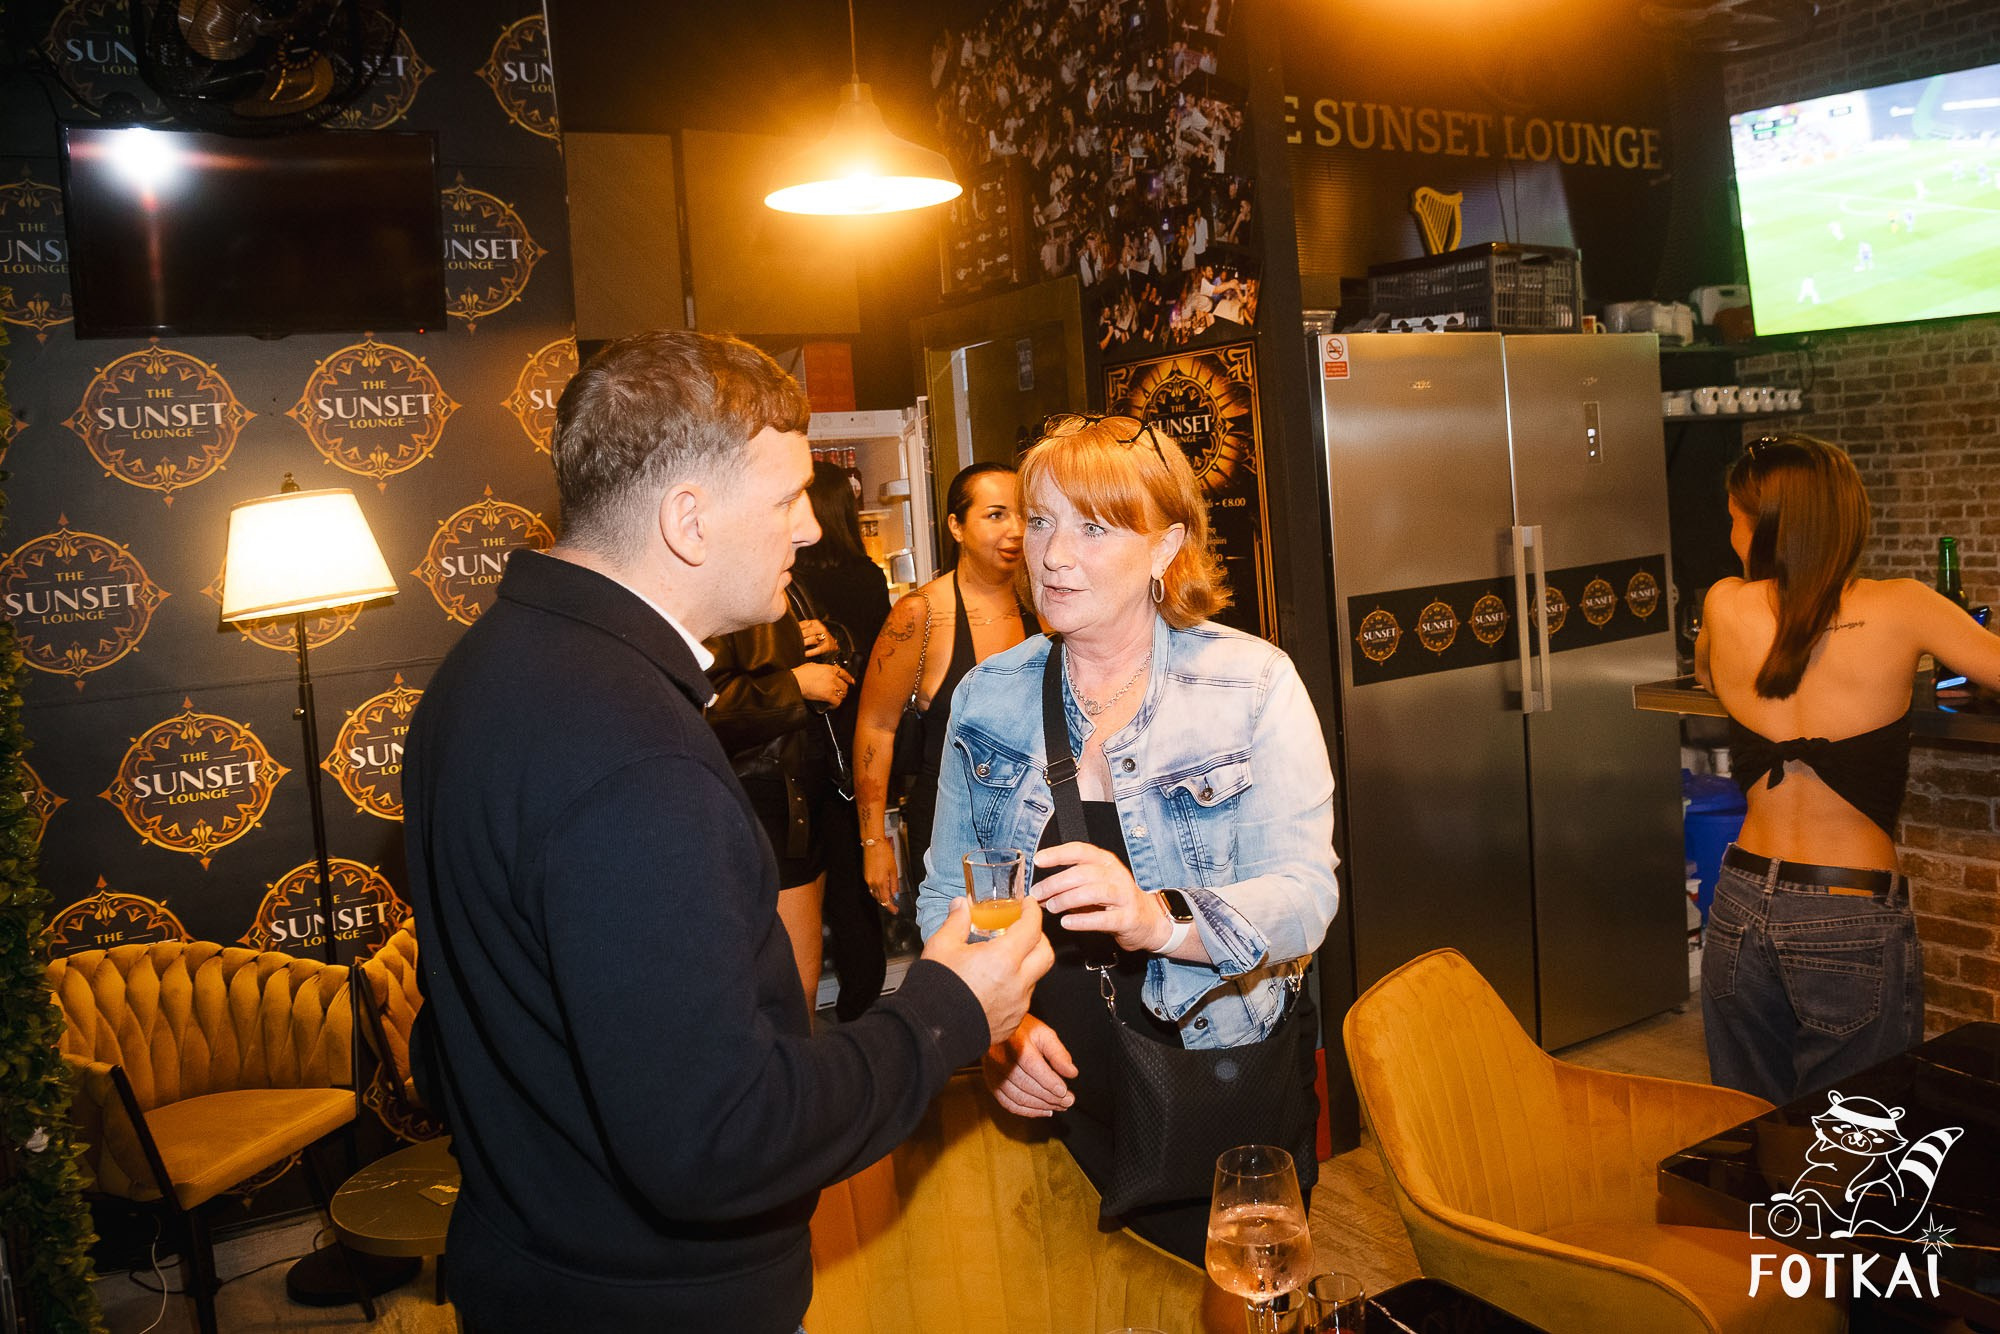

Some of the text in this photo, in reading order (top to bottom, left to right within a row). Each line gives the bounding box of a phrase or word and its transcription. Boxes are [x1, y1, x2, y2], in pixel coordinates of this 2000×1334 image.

[66, 39, 137, 63] SUN
[504, 61, 552, 83] SUN
[1313, 99, 1494, 158] SUNSET
[1502, 115, 1662, 171] LOUNGE
[18, 222, 47, 232] THE
[452, 223, 477, 233] THE
[446, 261, 495, 270] OUNGE
[361, 380, 388, 390] THE
[145, 388, 174, 399] THE
[317, 393, 435, 420] SUNSET
[97, 402, 227, 431] SUNSET
[350, 417, 406, 429] LOUNGE
[133, 427, 195, 440] LOUNGE
[1222, 497, 1246, 508] €8.00
[481, 536, 506, 547] THE
[55, 570, 86, 582] THE
[5, 583, 141, 617] SUNSET
[42, 610, 106, 625] LOUNGE
[1475, 612, 1504, 625] SUNSET
[1422, 619, 1453, 632] SUNSET
[1363, 627, 1396, 641] SUNSET
[391, 725, 410, 737] TH
[180, 751, 209, 764] THE
[350, 742, 404, 769] SUN
[134, 760, 261, 799] SUNSET
[169, 787, 230, 806] LOUNGE
[314, 894, 341, 907] TE
[94, 931, 124, 944] THE
